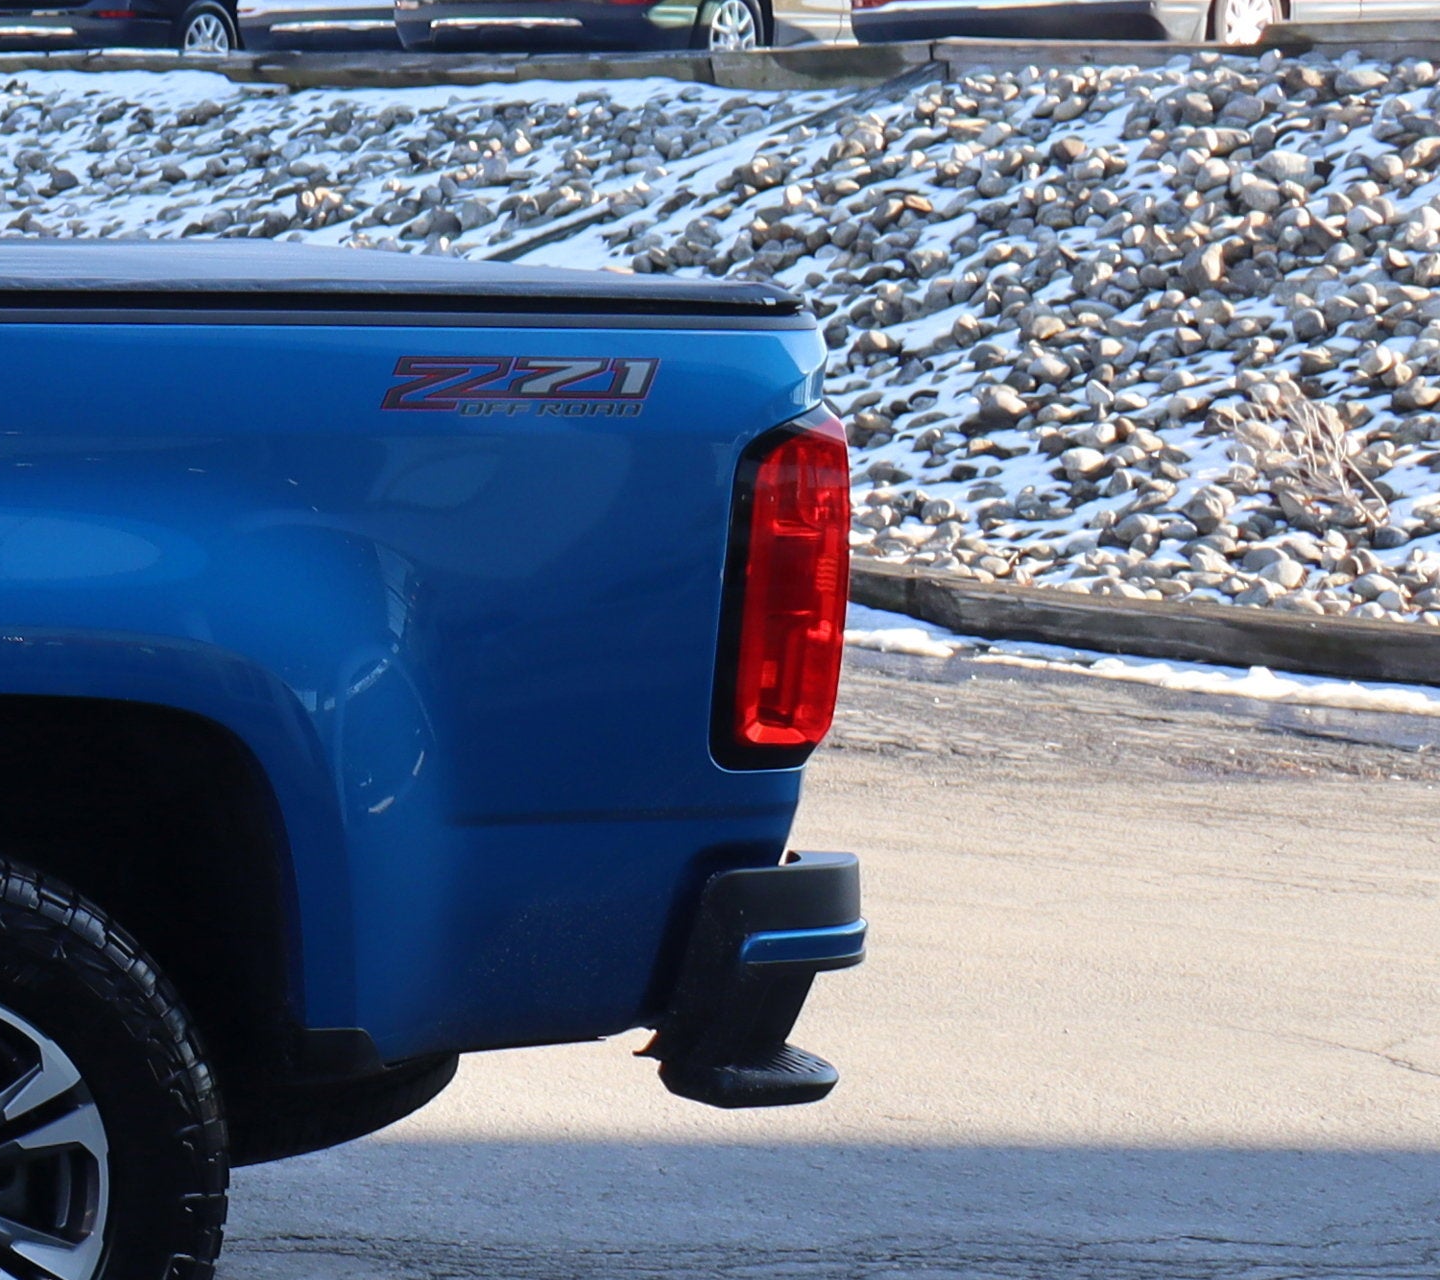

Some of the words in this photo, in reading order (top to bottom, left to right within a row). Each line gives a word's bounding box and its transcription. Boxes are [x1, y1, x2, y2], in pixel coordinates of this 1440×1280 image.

[380, 355, 661, 412] Z71
[459, 401, 530, 417] OFF
[535, 401, 645, 418] ROAD
